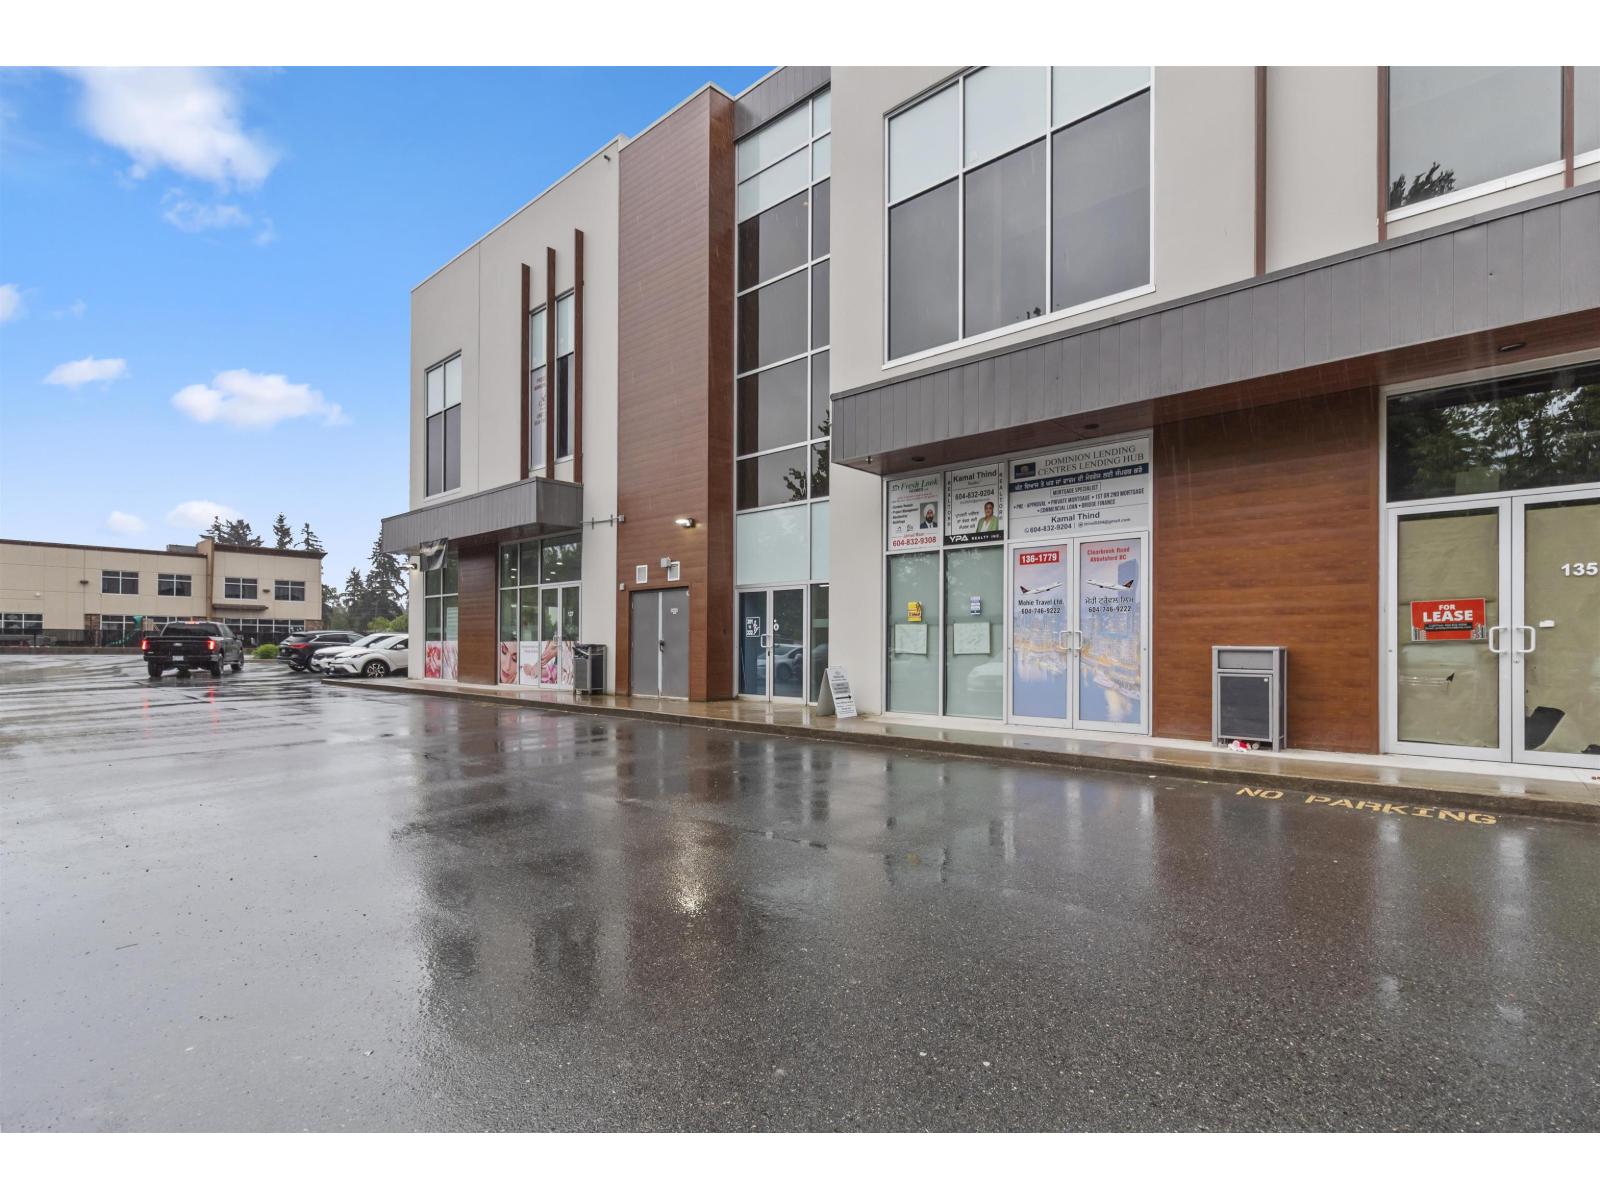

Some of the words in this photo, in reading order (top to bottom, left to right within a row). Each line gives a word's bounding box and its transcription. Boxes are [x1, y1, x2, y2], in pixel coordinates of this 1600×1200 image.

[1045, 452, 1091, 467] DOMINION
[1094, 445, 1136, 459] LENDING
[1038, 463, 1077, 476] CENTRES
[1080, 457, 1121, 470] LENDING
[1123, 453, 1144, 464] HUB
[953, 472, 975, 483] Kamal
[977, 469, 997, 480] Thind
[1051, 514, 1076, 523] Kamal
[1078, 511, 1100, 520] Thind
[950, 535, 969, 543] YPA
[1087, 548, 1114, 556] Clearbrook
[1021, 553, 1057, 564] 136-1779
[1090, 555, 1118, 563] Abbotsford
[1560, 562, 1598, 576] 135
[1035, 598, 1052, 606] Travel
[1053, 598, 1064, 606] Ltd.
[1021, 607, 1060, 615] 604-746-9222
[1423, 610, 1473, 622] LEASE
[1236, 787, 1283, 799] NO
[1304, 794, 1497, 824] PARKING
